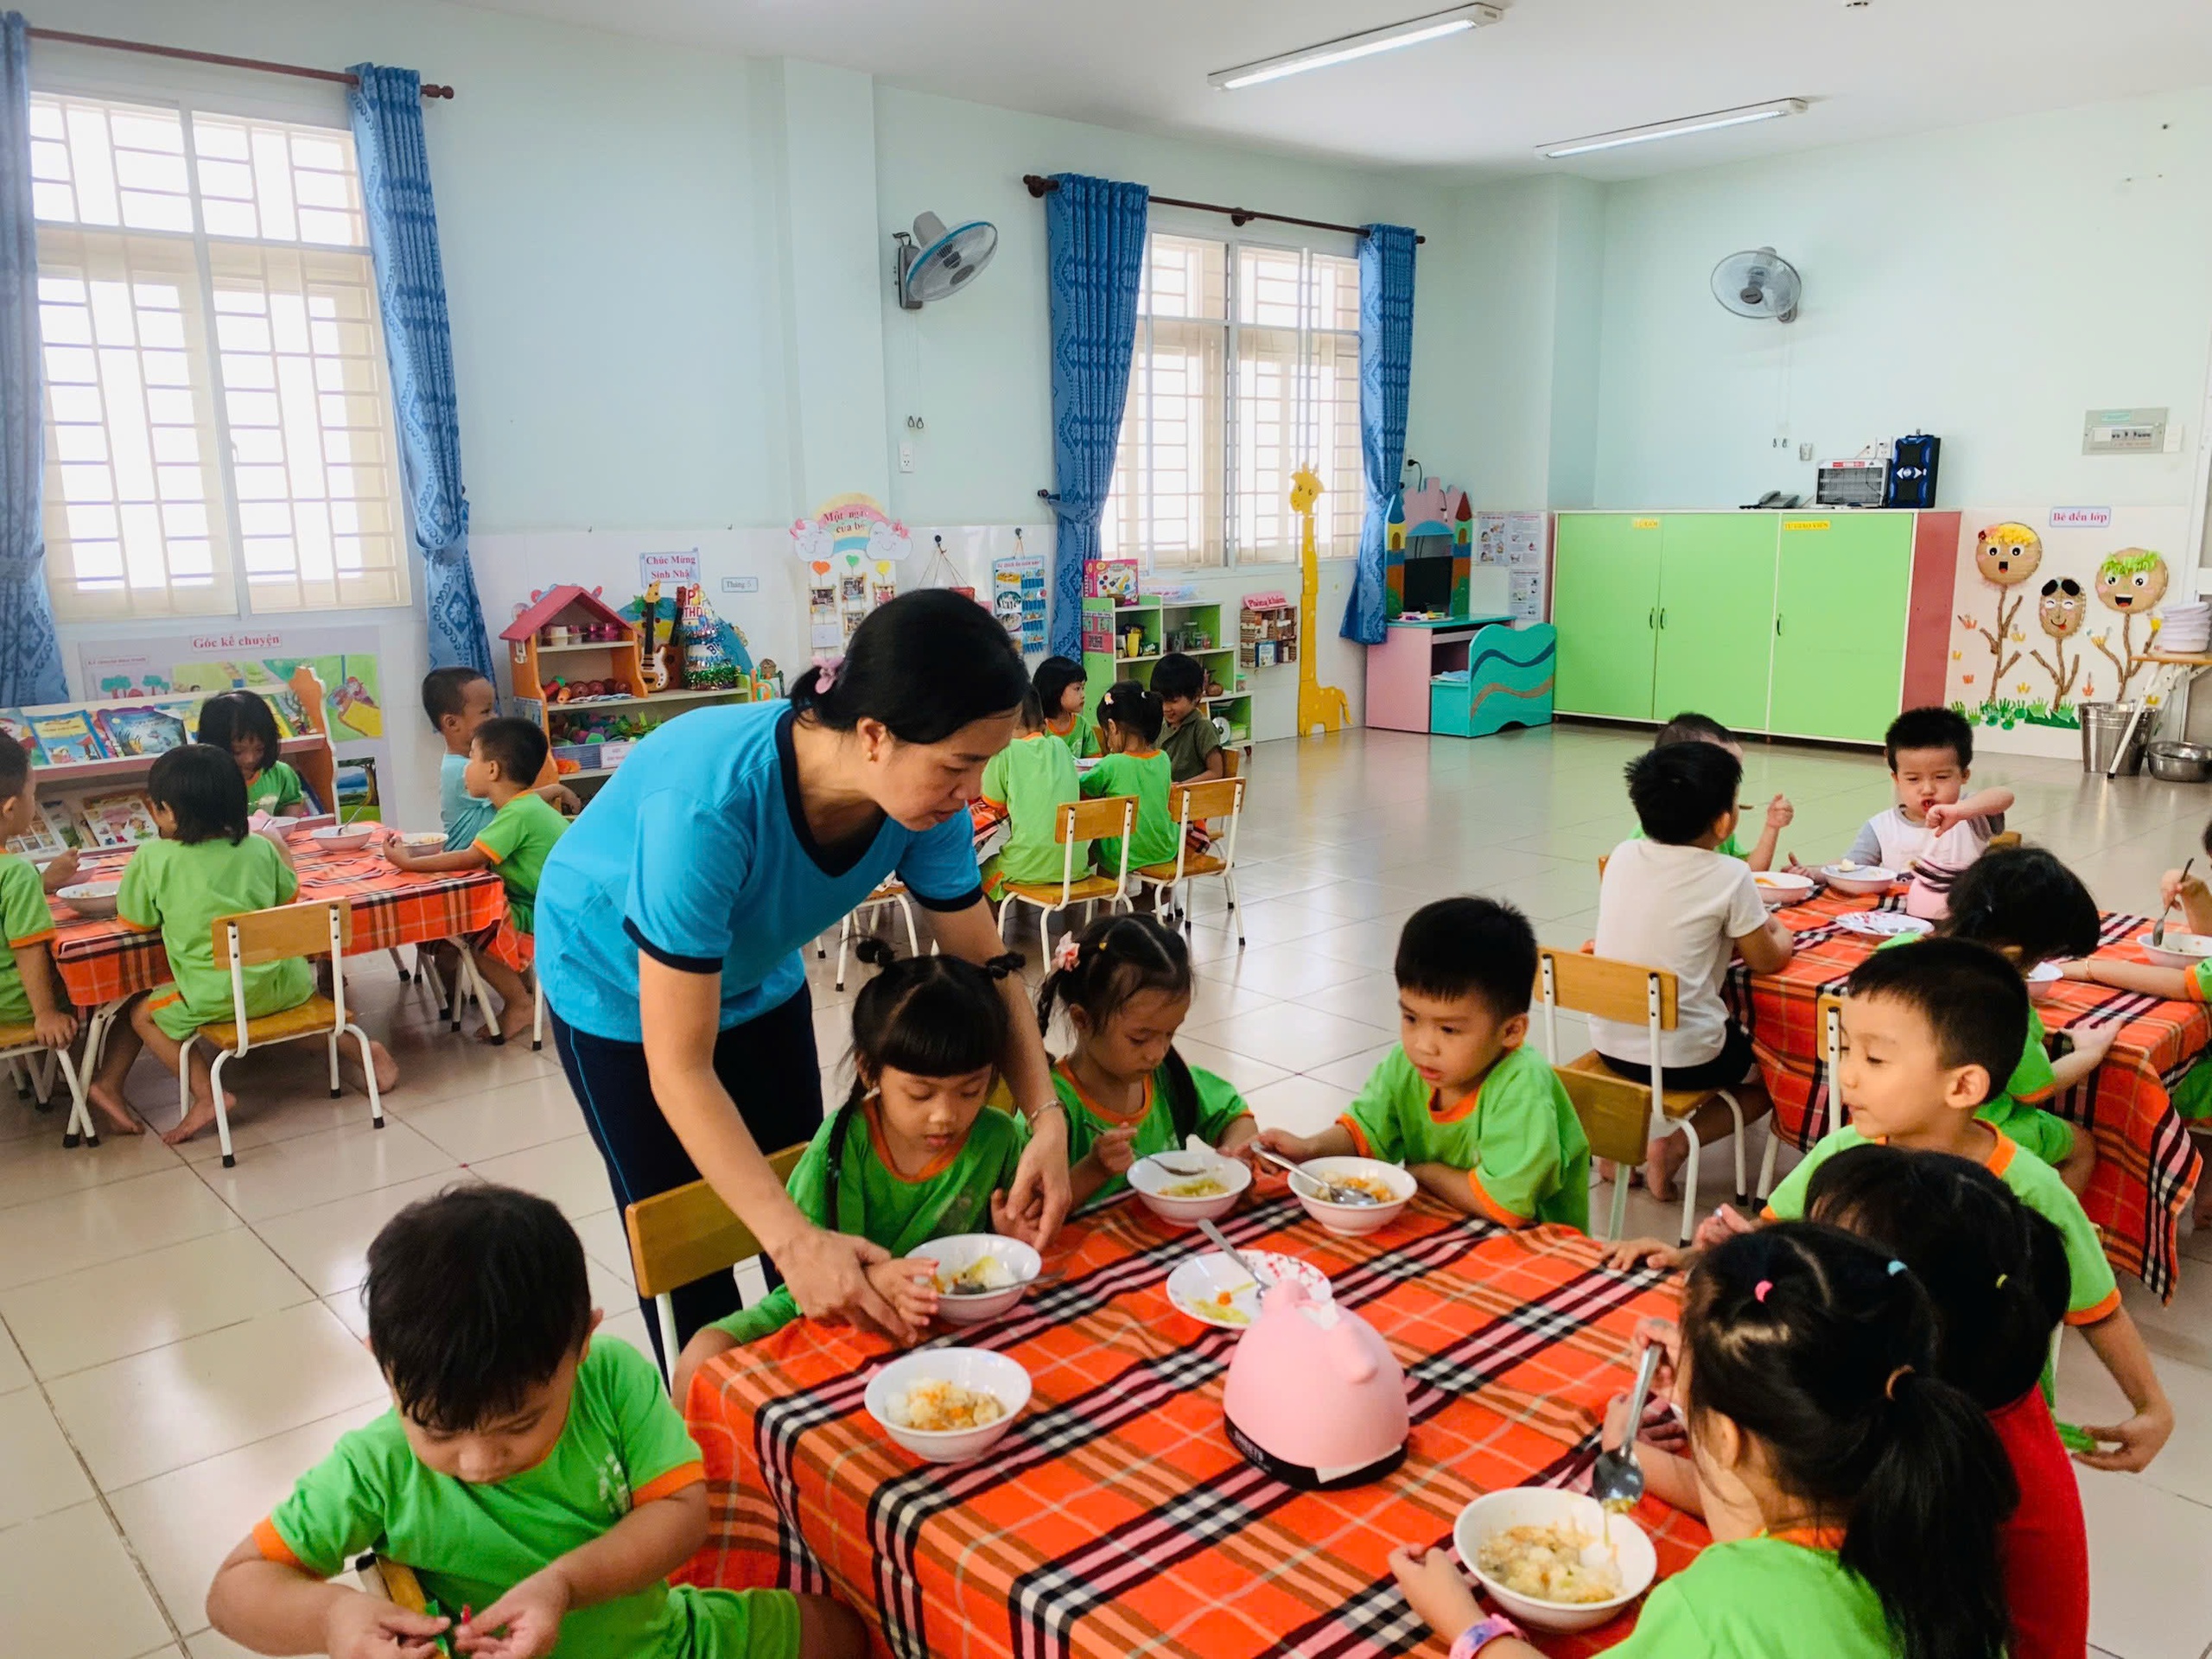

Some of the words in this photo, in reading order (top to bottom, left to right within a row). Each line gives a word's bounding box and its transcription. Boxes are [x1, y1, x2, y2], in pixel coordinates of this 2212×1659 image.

[823, 512, 843, 523] Một
[836, 522, 852, 533] của
[645, 556, 669, 565] Chúc
[671, 555, 696, 565] Mừng
[651, 570, 671, 580] Sinh
[673, 569, 690, 580] Nhậ
[193, 638, 218, 649] Góc
[238, 635, 280, 647] chuyện
